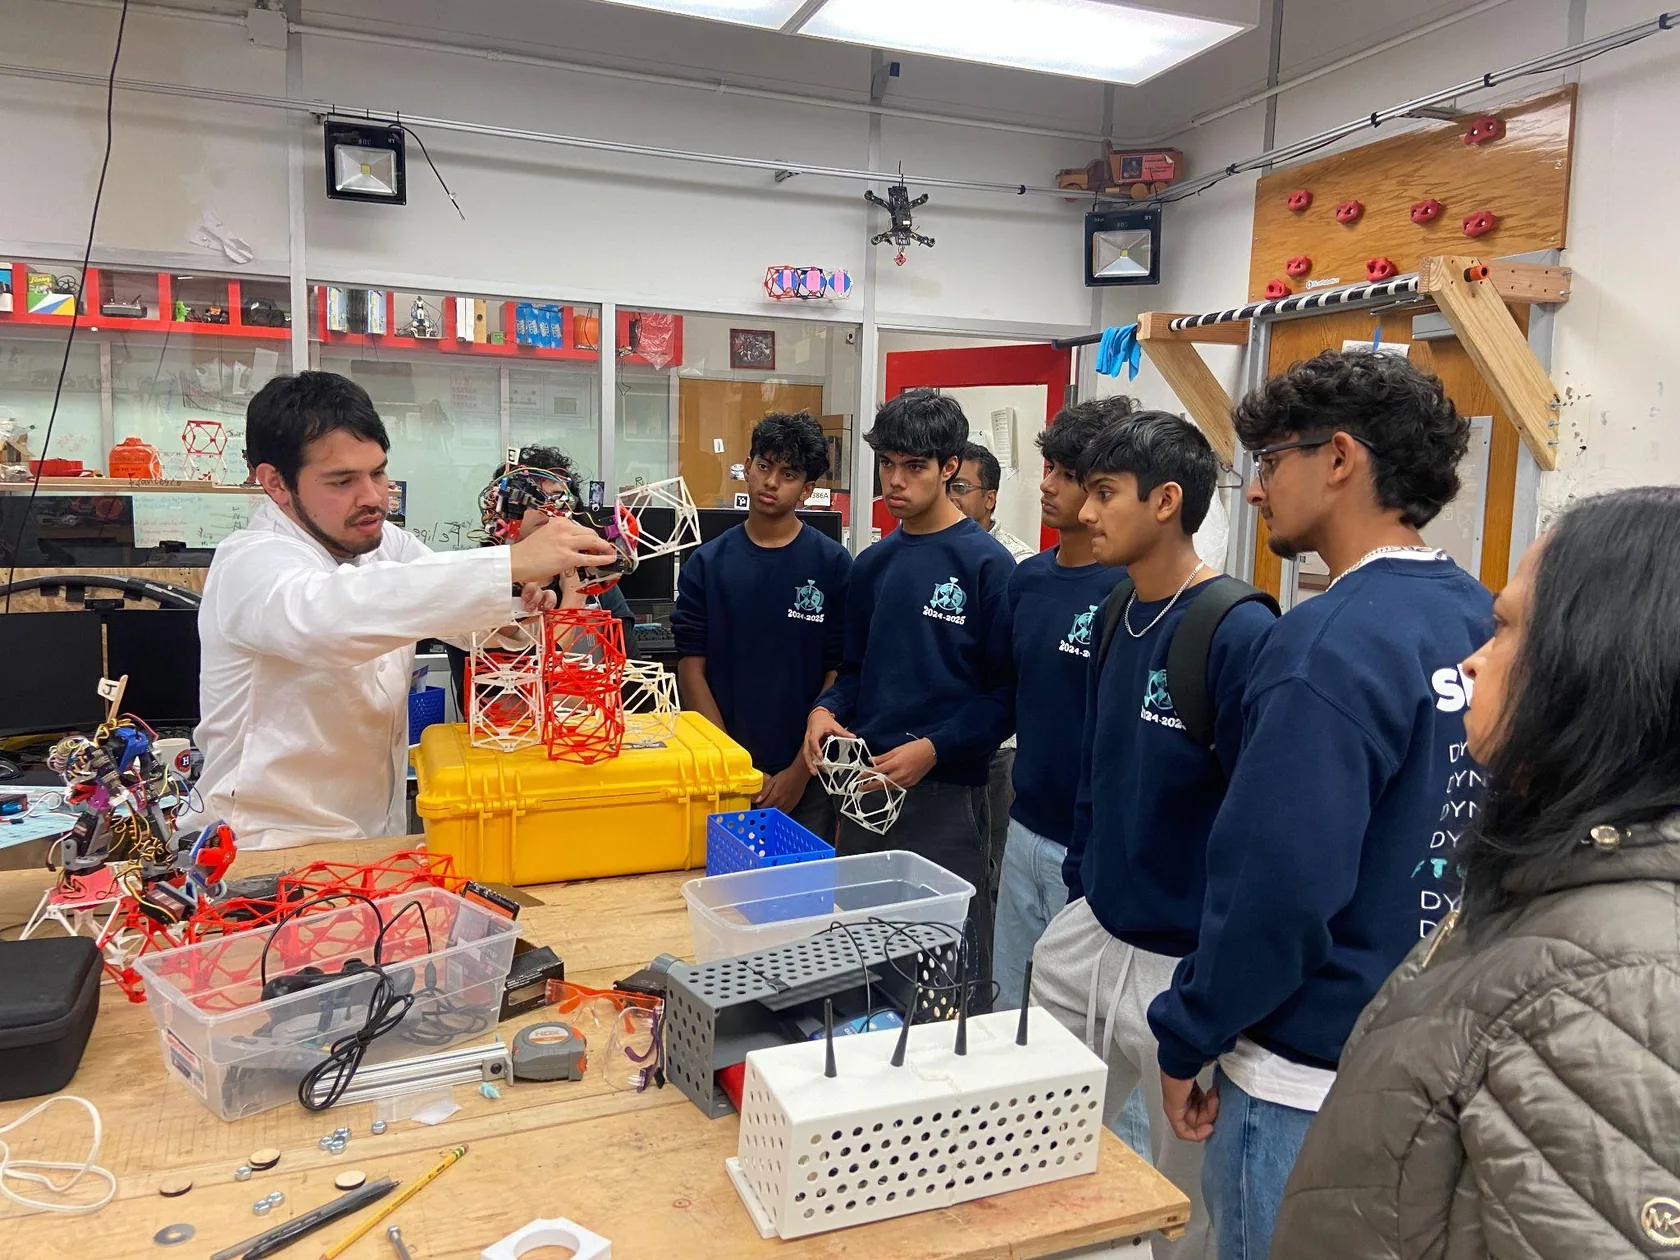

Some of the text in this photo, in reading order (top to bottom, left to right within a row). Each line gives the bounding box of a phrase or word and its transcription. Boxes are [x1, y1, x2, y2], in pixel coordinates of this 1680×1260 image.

[787, 608, 825, 623] 2024-2025
[922, 605, 967, 625] 2024-2025
[102, 683, 117, 695] J
[182, 756, 189, 766] H
[1449, 740, 1468, 763] DY
[1446, 770, 1487, 793] DYN
[1429, 830, 1464, 849] DY
[1420, 890, 1462, 912] DY
[1419, 919, 1438, 939] D
